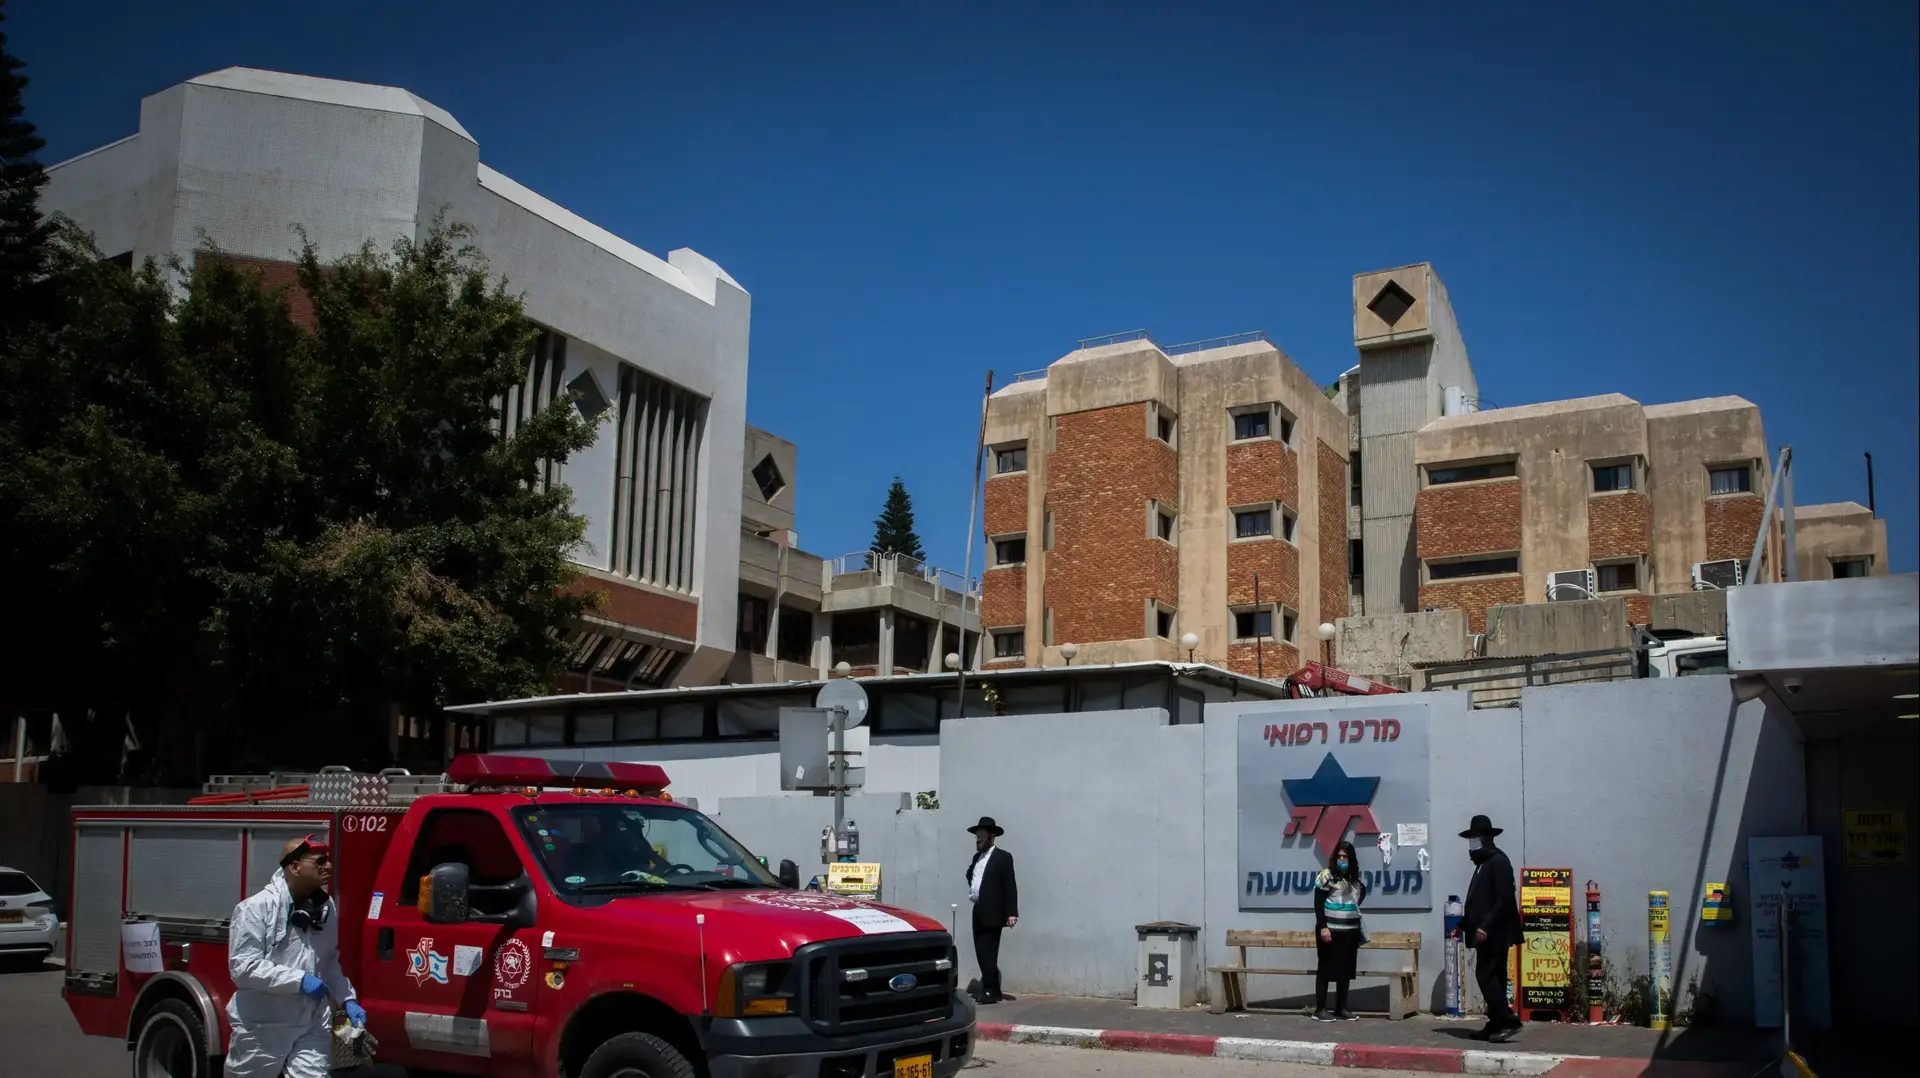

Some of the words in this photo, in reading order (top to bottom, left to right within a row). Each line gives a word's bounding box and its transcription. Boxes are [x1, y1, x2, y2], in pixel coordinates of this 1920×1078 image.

[1264, 721, 1329, 746] רפואי
[1338, 718, 1401, 743] מרכז
[360, 815, 387, 832] 102
[1246, 871, 1317, 895] שועה
[1359, 870, 1423, 894] מעינ
[1530, 870, 1559, 878] לאחים
[1532, 958, 1560, 971] פדיון
